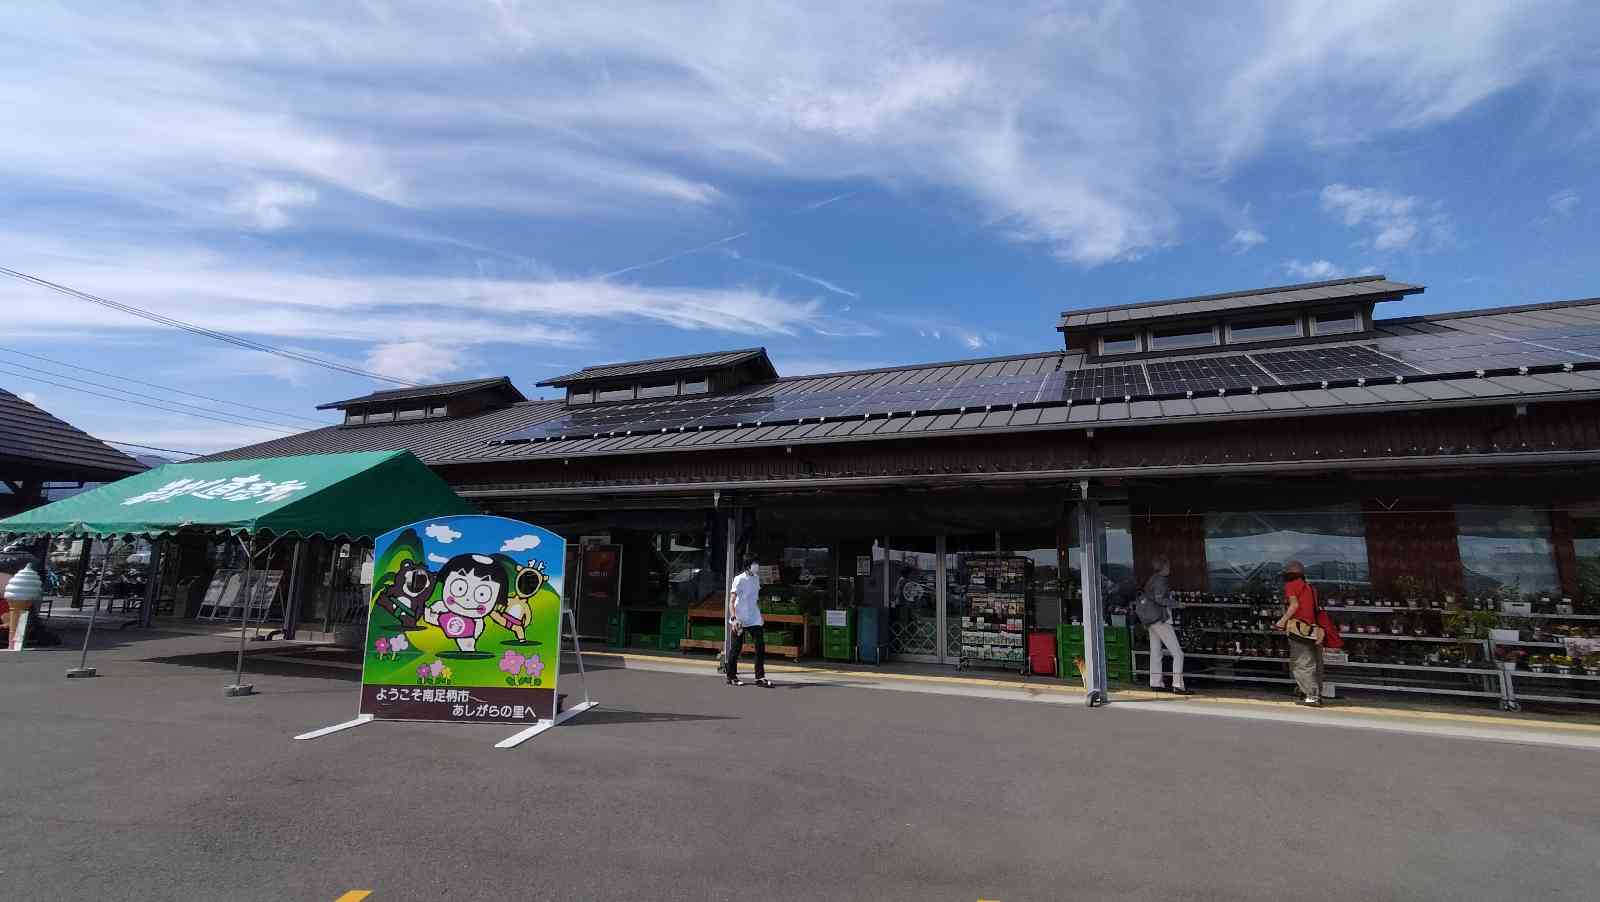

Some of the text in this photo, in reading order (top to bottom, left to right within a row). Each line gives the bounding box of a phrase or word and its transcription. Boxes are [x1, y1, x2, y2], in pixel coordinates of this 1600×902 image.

[376, 688, 470, 703] ようこそ南足柄市
[452, 704, 537, 719] あしがらの里へ
